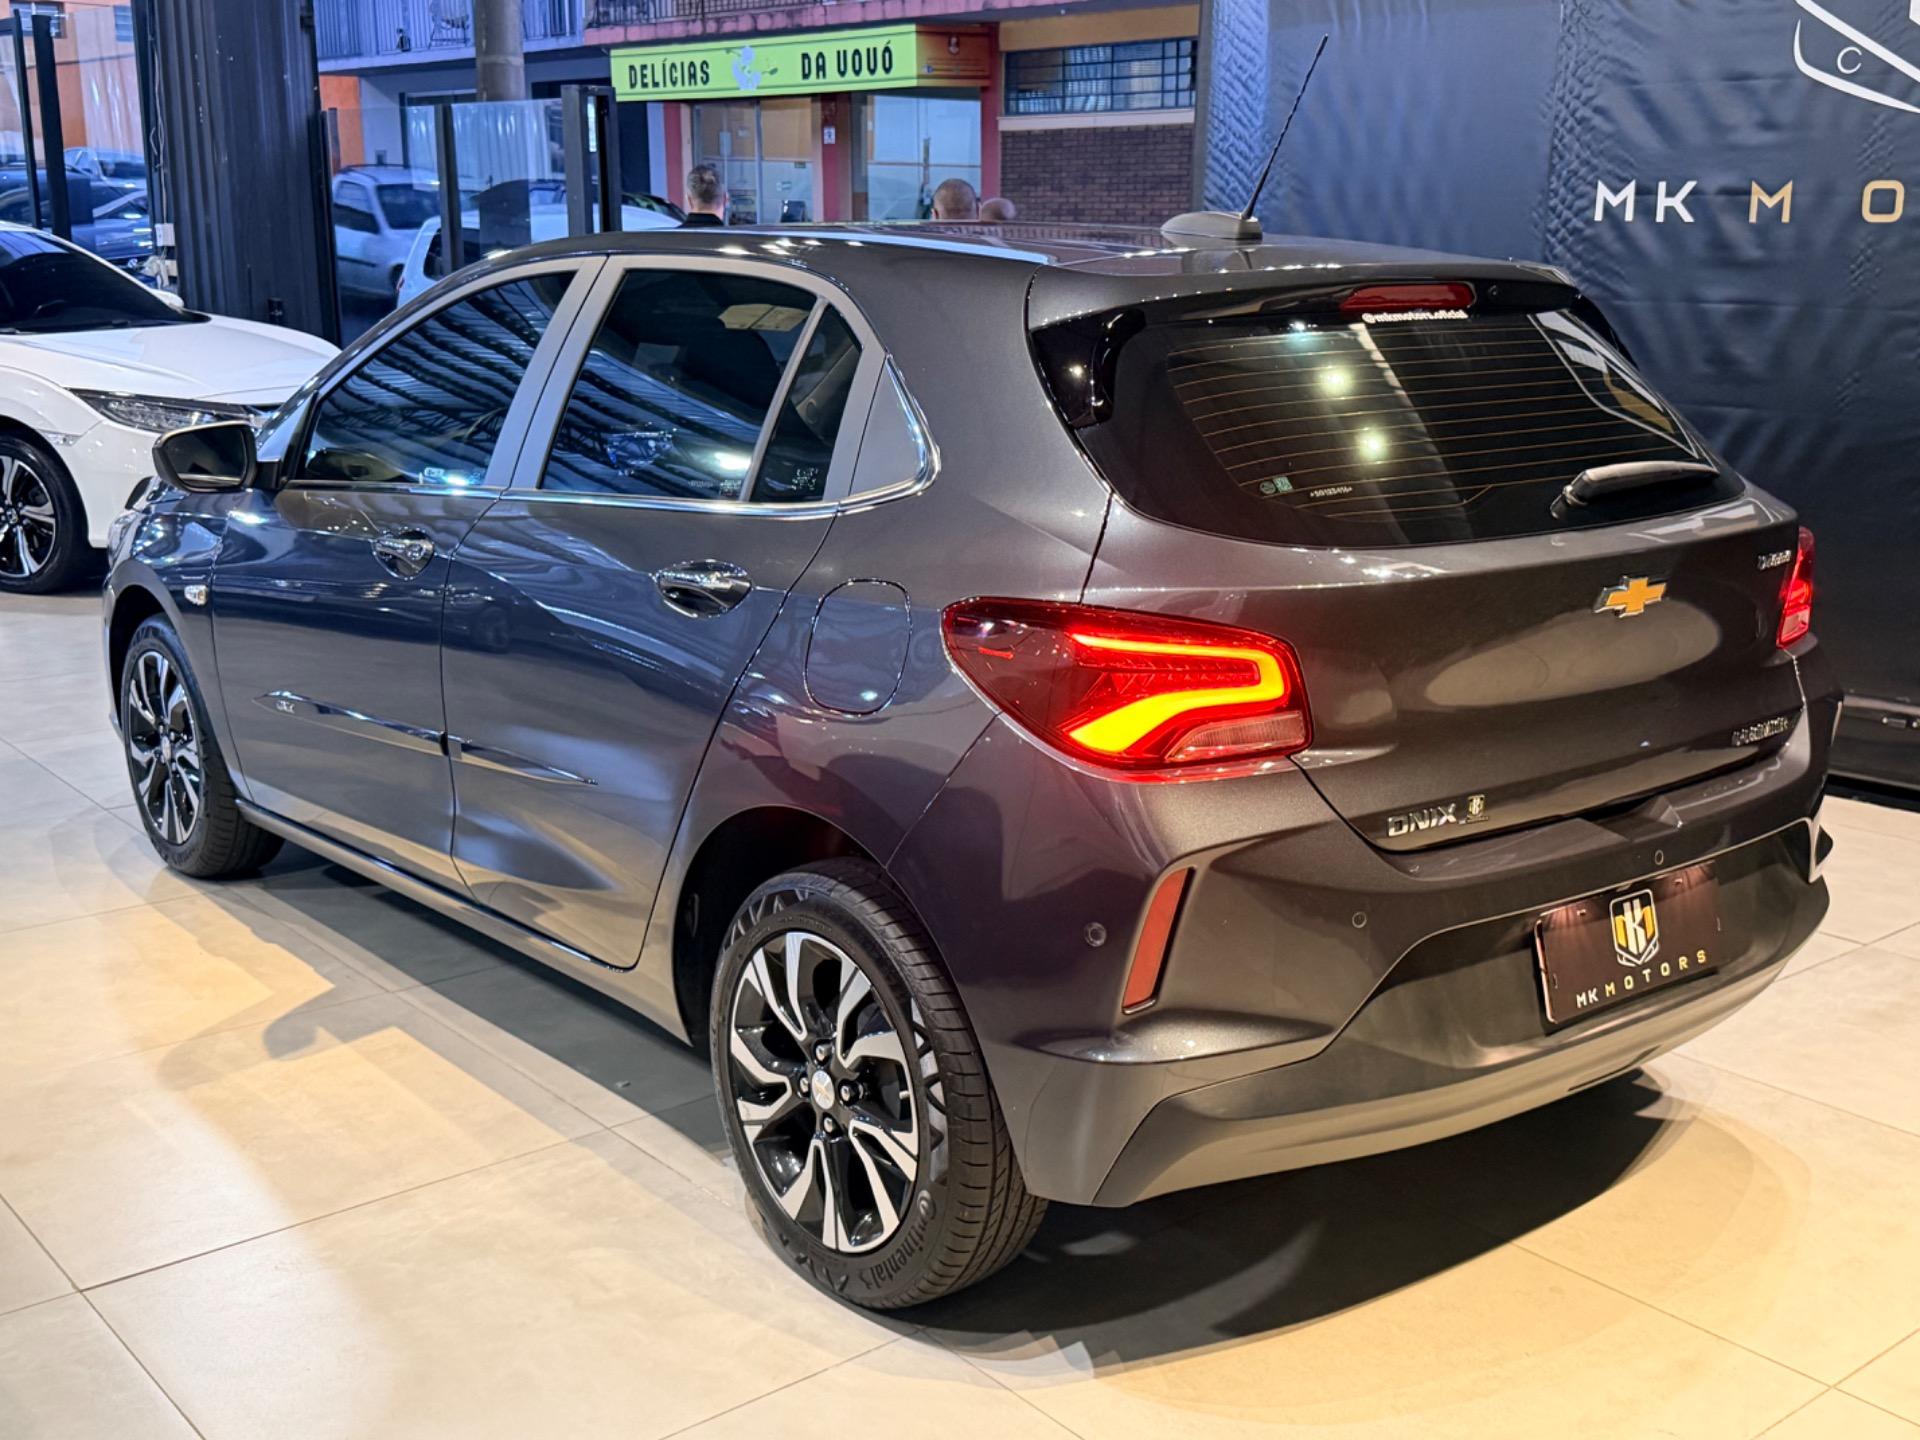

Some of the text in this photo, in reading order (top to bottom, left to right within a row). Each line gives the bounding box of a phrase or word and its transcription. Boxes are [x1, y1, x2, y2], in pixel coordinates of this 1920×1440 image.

[628, 58, 710, 89] DELÍCIAS
[801, 51, 827, 80] DA
[1594, 179, 1698, 223] MK
[1388, 803, 1456, 837] ONIX
[870, 1189, 937, 1289] Continental
